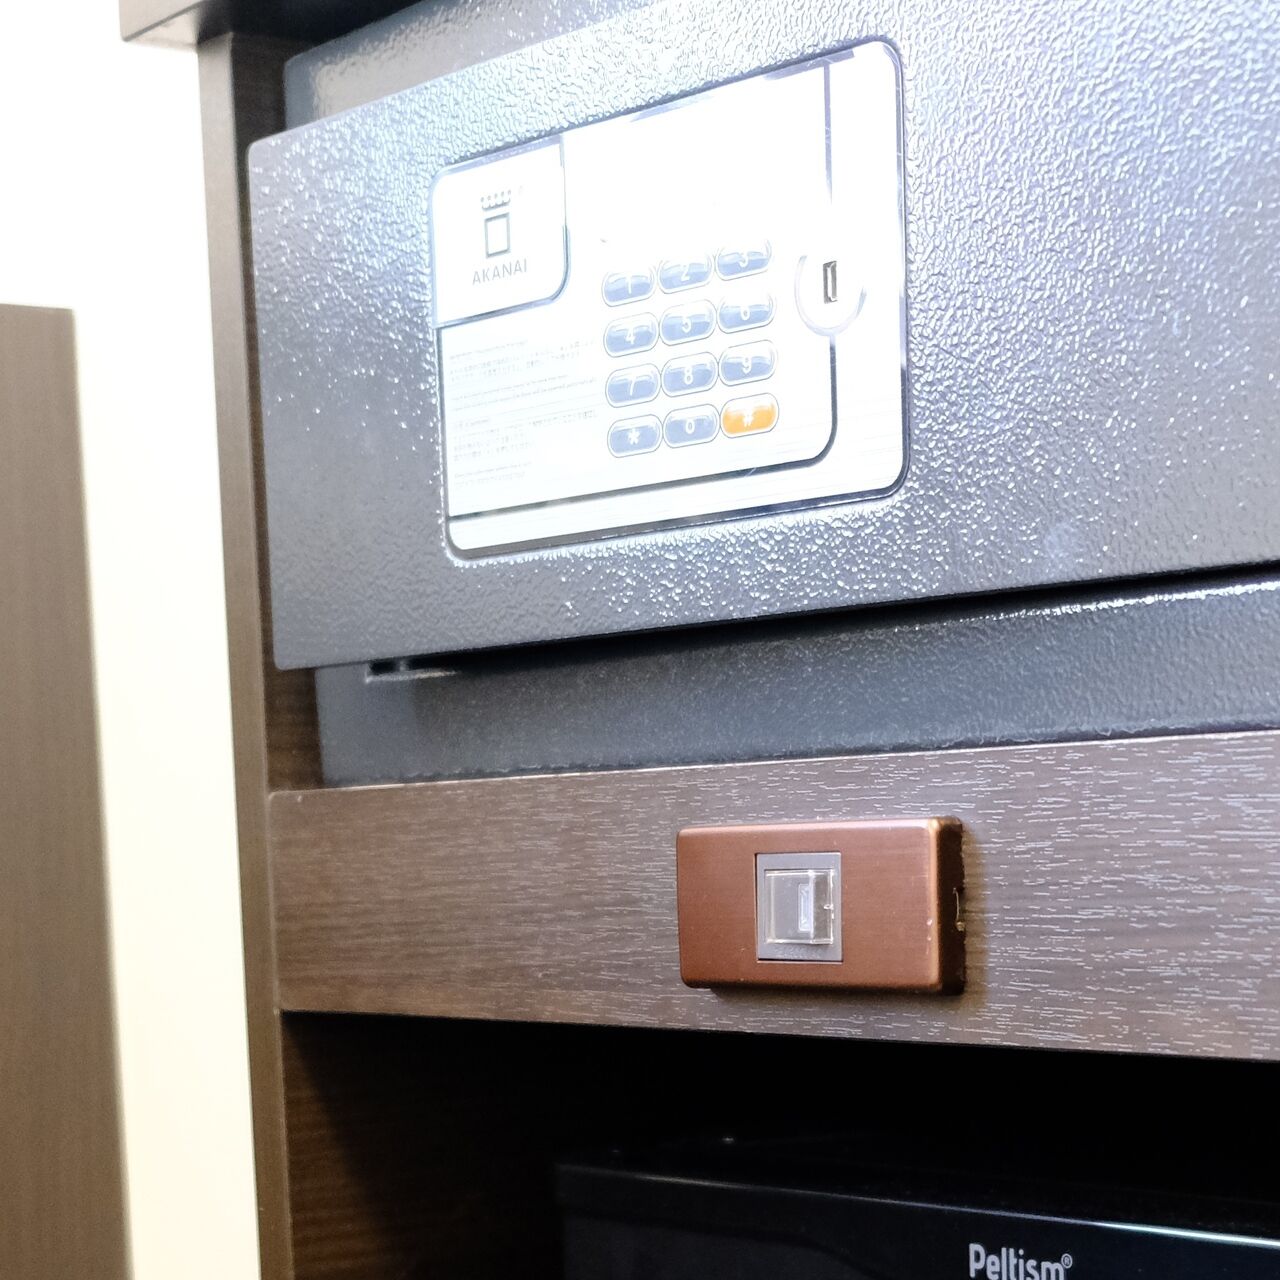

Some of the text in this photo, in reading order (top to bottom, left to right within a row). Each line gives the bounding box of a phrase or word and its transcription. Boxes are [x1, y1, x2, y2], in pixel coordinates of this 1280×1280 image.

[471, 257, 528, 286] AKANAI
[625, 327, 636, 345] 4
[684, 365, 694, 385] 8
[742, 356, 752, 375] 9
[685, 417, 695, 434] 0
